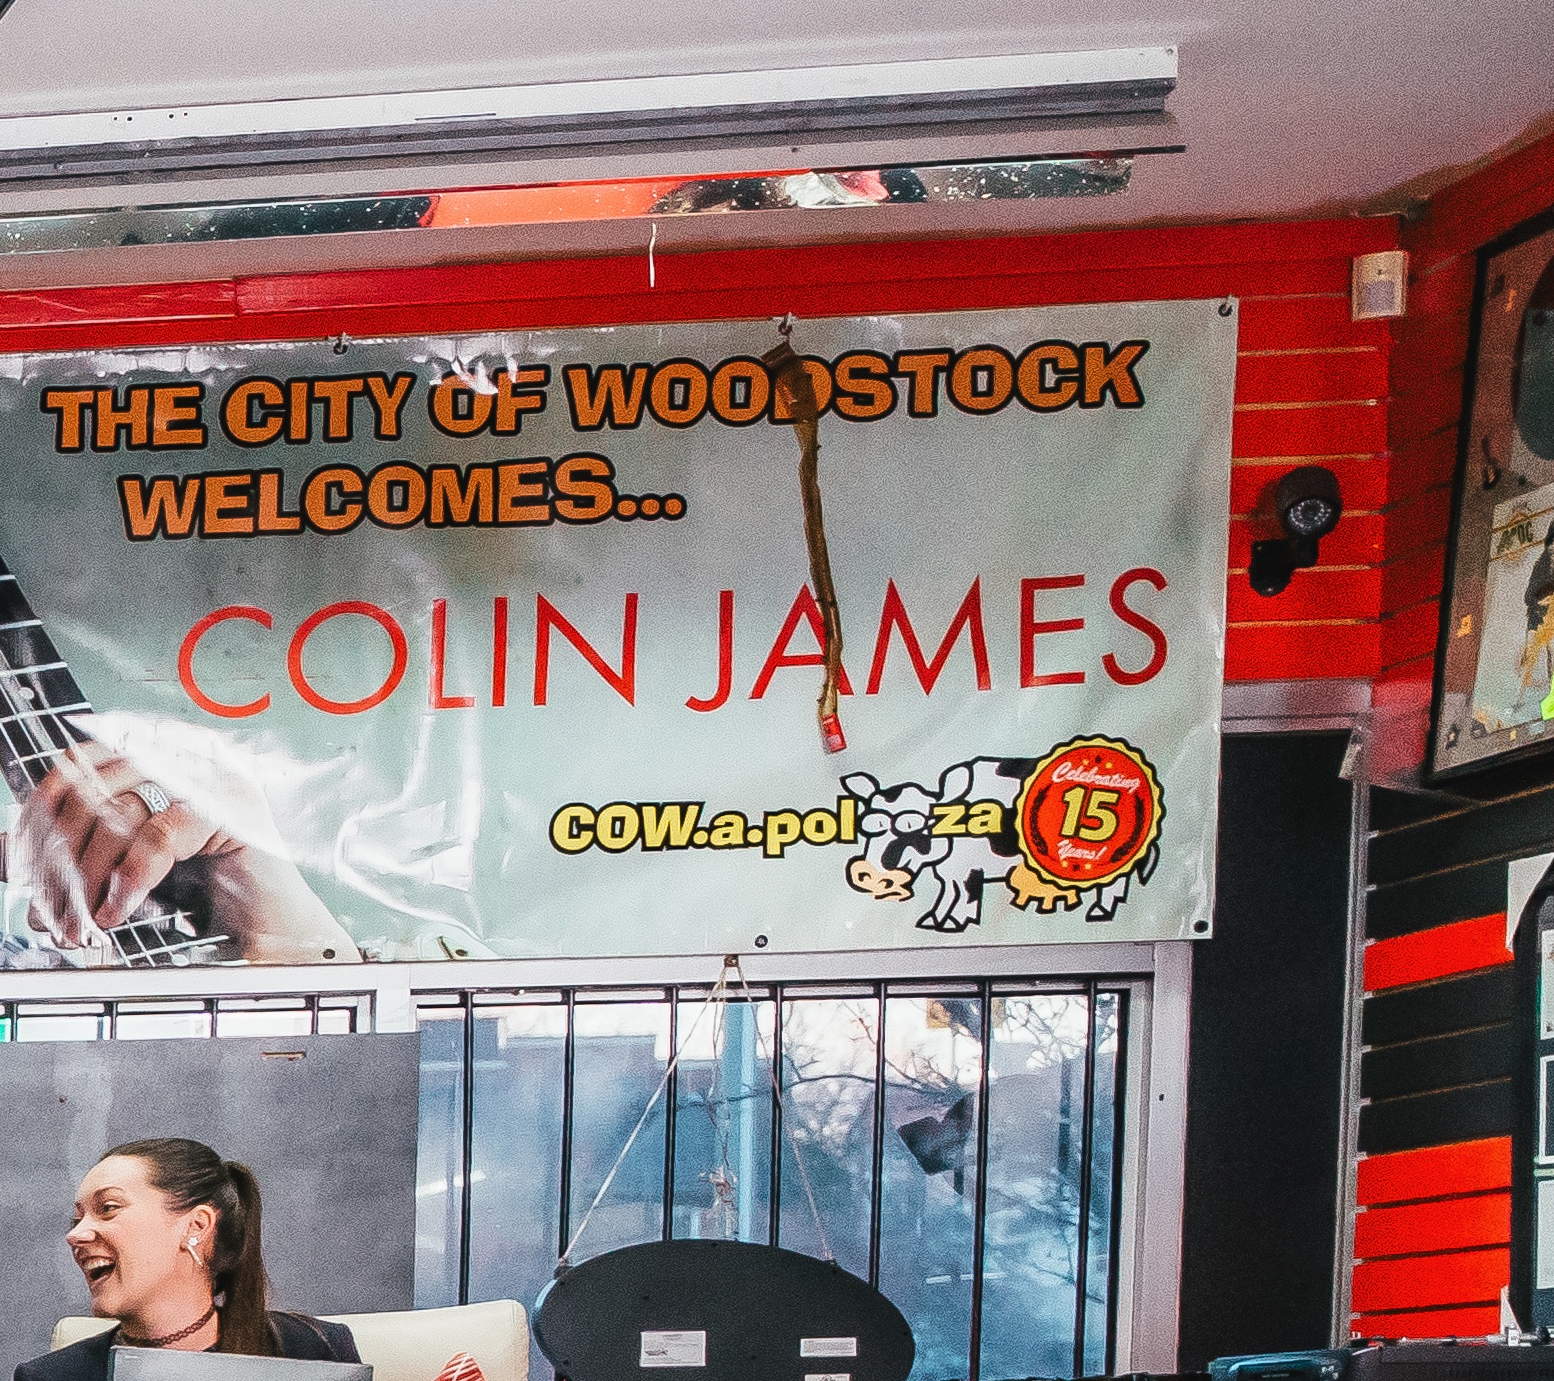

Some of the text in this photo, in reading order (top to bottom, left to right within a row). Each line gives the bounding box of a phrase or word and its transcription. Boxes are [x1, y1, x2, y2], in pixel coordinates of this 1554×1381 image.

[42, 337, 1150, 454] THE CITY OF WOODSTOCK
[119, 450, 687, 542] WELCOMES...
[177, 567, 1170, 719] COLIN JAMES
[1051, 760, 1142, 794] Celebrating
[1060, 786, 1120, 843] 15
[1056, 843, 1105, 864] Years!
